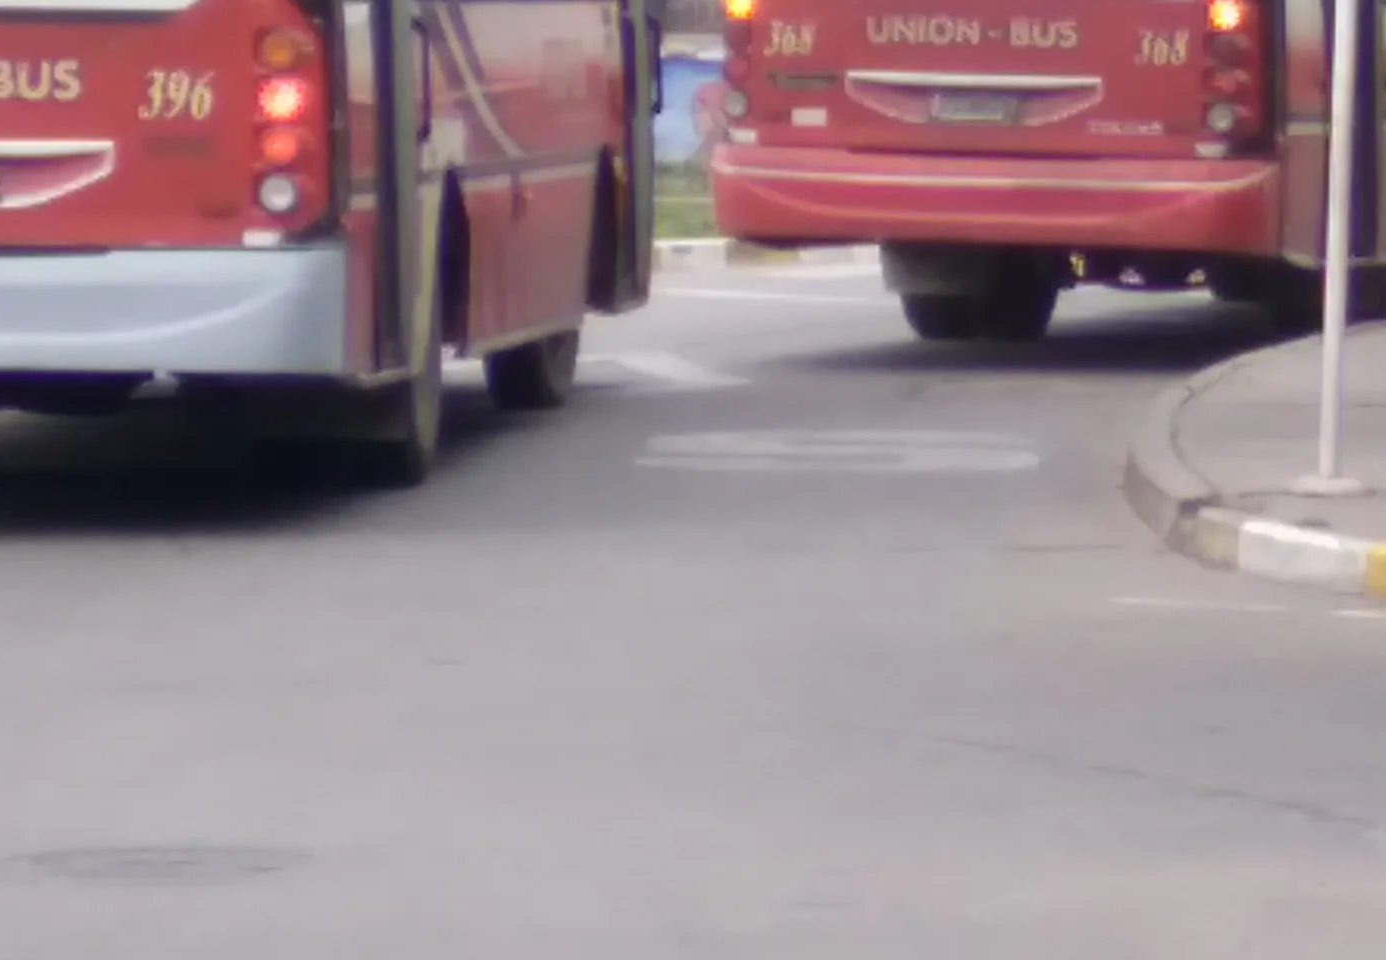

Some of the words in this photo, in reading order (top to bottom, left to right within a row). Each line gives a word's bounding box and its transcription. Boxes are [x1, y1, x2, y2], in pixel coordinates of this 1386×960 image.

[866, 16, 980, 46] UNION
[1010, 20, 1079, 49] BUS
[137, 67, 213, 121] 396
